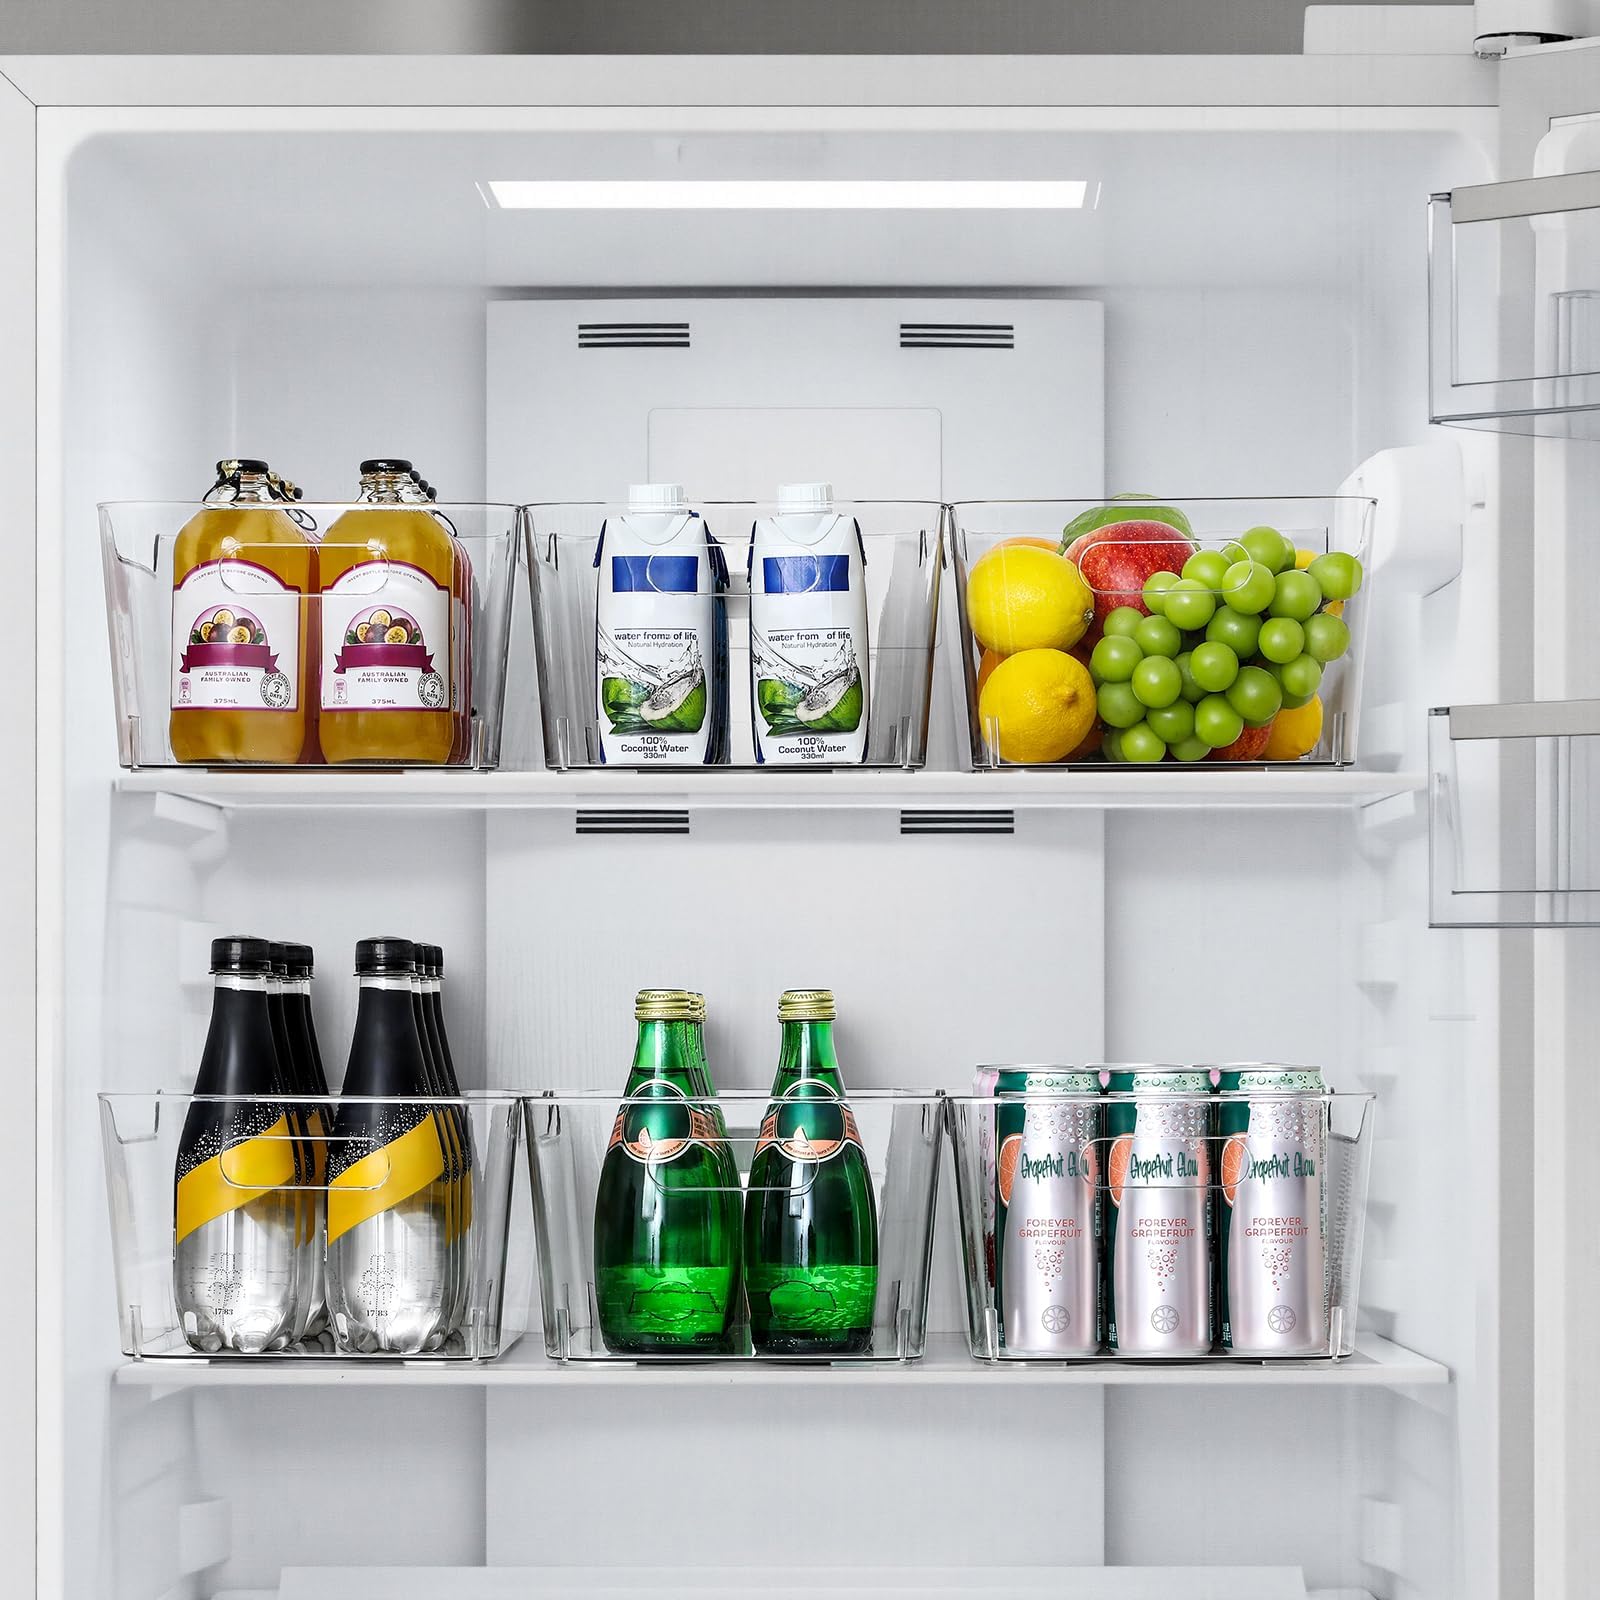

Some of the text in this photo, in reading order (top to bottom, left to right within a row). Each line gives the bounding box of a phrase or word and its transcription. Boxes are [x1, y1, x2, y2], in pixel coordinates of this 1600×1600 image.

[673, 632, 682, 640] of
[684, 632, 697, 640] life
[797, 632, 819, 640] from
[826, 631, 836, 639] of
[838, 631, 851, 639] life
[274, 685, 280, 693] 2
[430, 685, 436, 693] 2
[640, 736, 667, 744] 100%
[797, 737, 824, 745] 100%
[621, 744, 689, 752] Coconut Water
[778, 744, 846, 753] Coconut Water
[1026, 1218, 1075, 1227] FOREVER
[1138, 1218, 1187, 1227] FOREVER
[1252, 1217, 1302, 1226] FOREVER
[1018, 1229, 1082, 1238] GRAPEFRUIT
[1131, 1228, 1195, 1238] GRAPEFRUIT
[1244, 1227, 1309, 1237] GRAPEFRUIT
